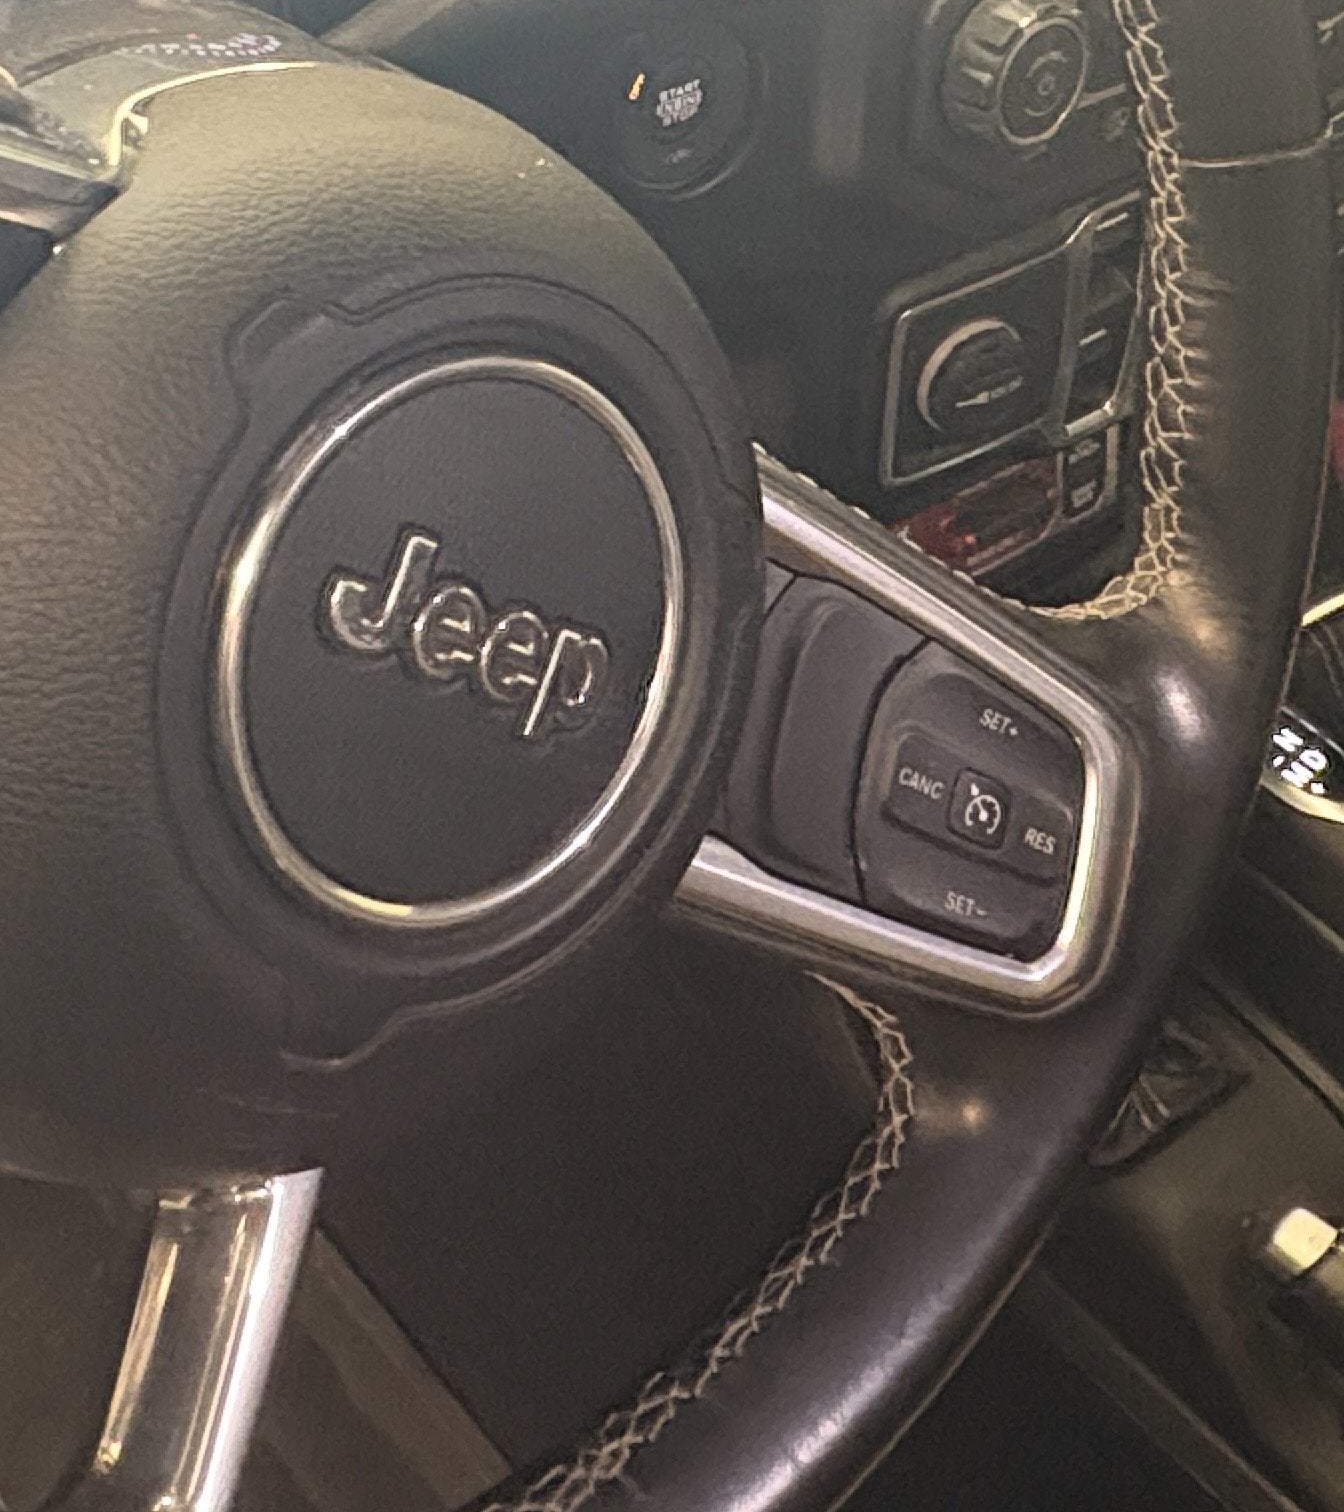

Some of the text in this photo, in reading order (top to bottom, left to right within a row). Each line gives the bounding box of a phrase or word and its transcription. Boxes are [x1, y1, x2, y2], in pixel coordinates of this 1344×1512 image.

[327, 532, 611, 738] Jeep
[898, 766, 945, 801] CANC
[1023, 826, 1055, 855] RES
